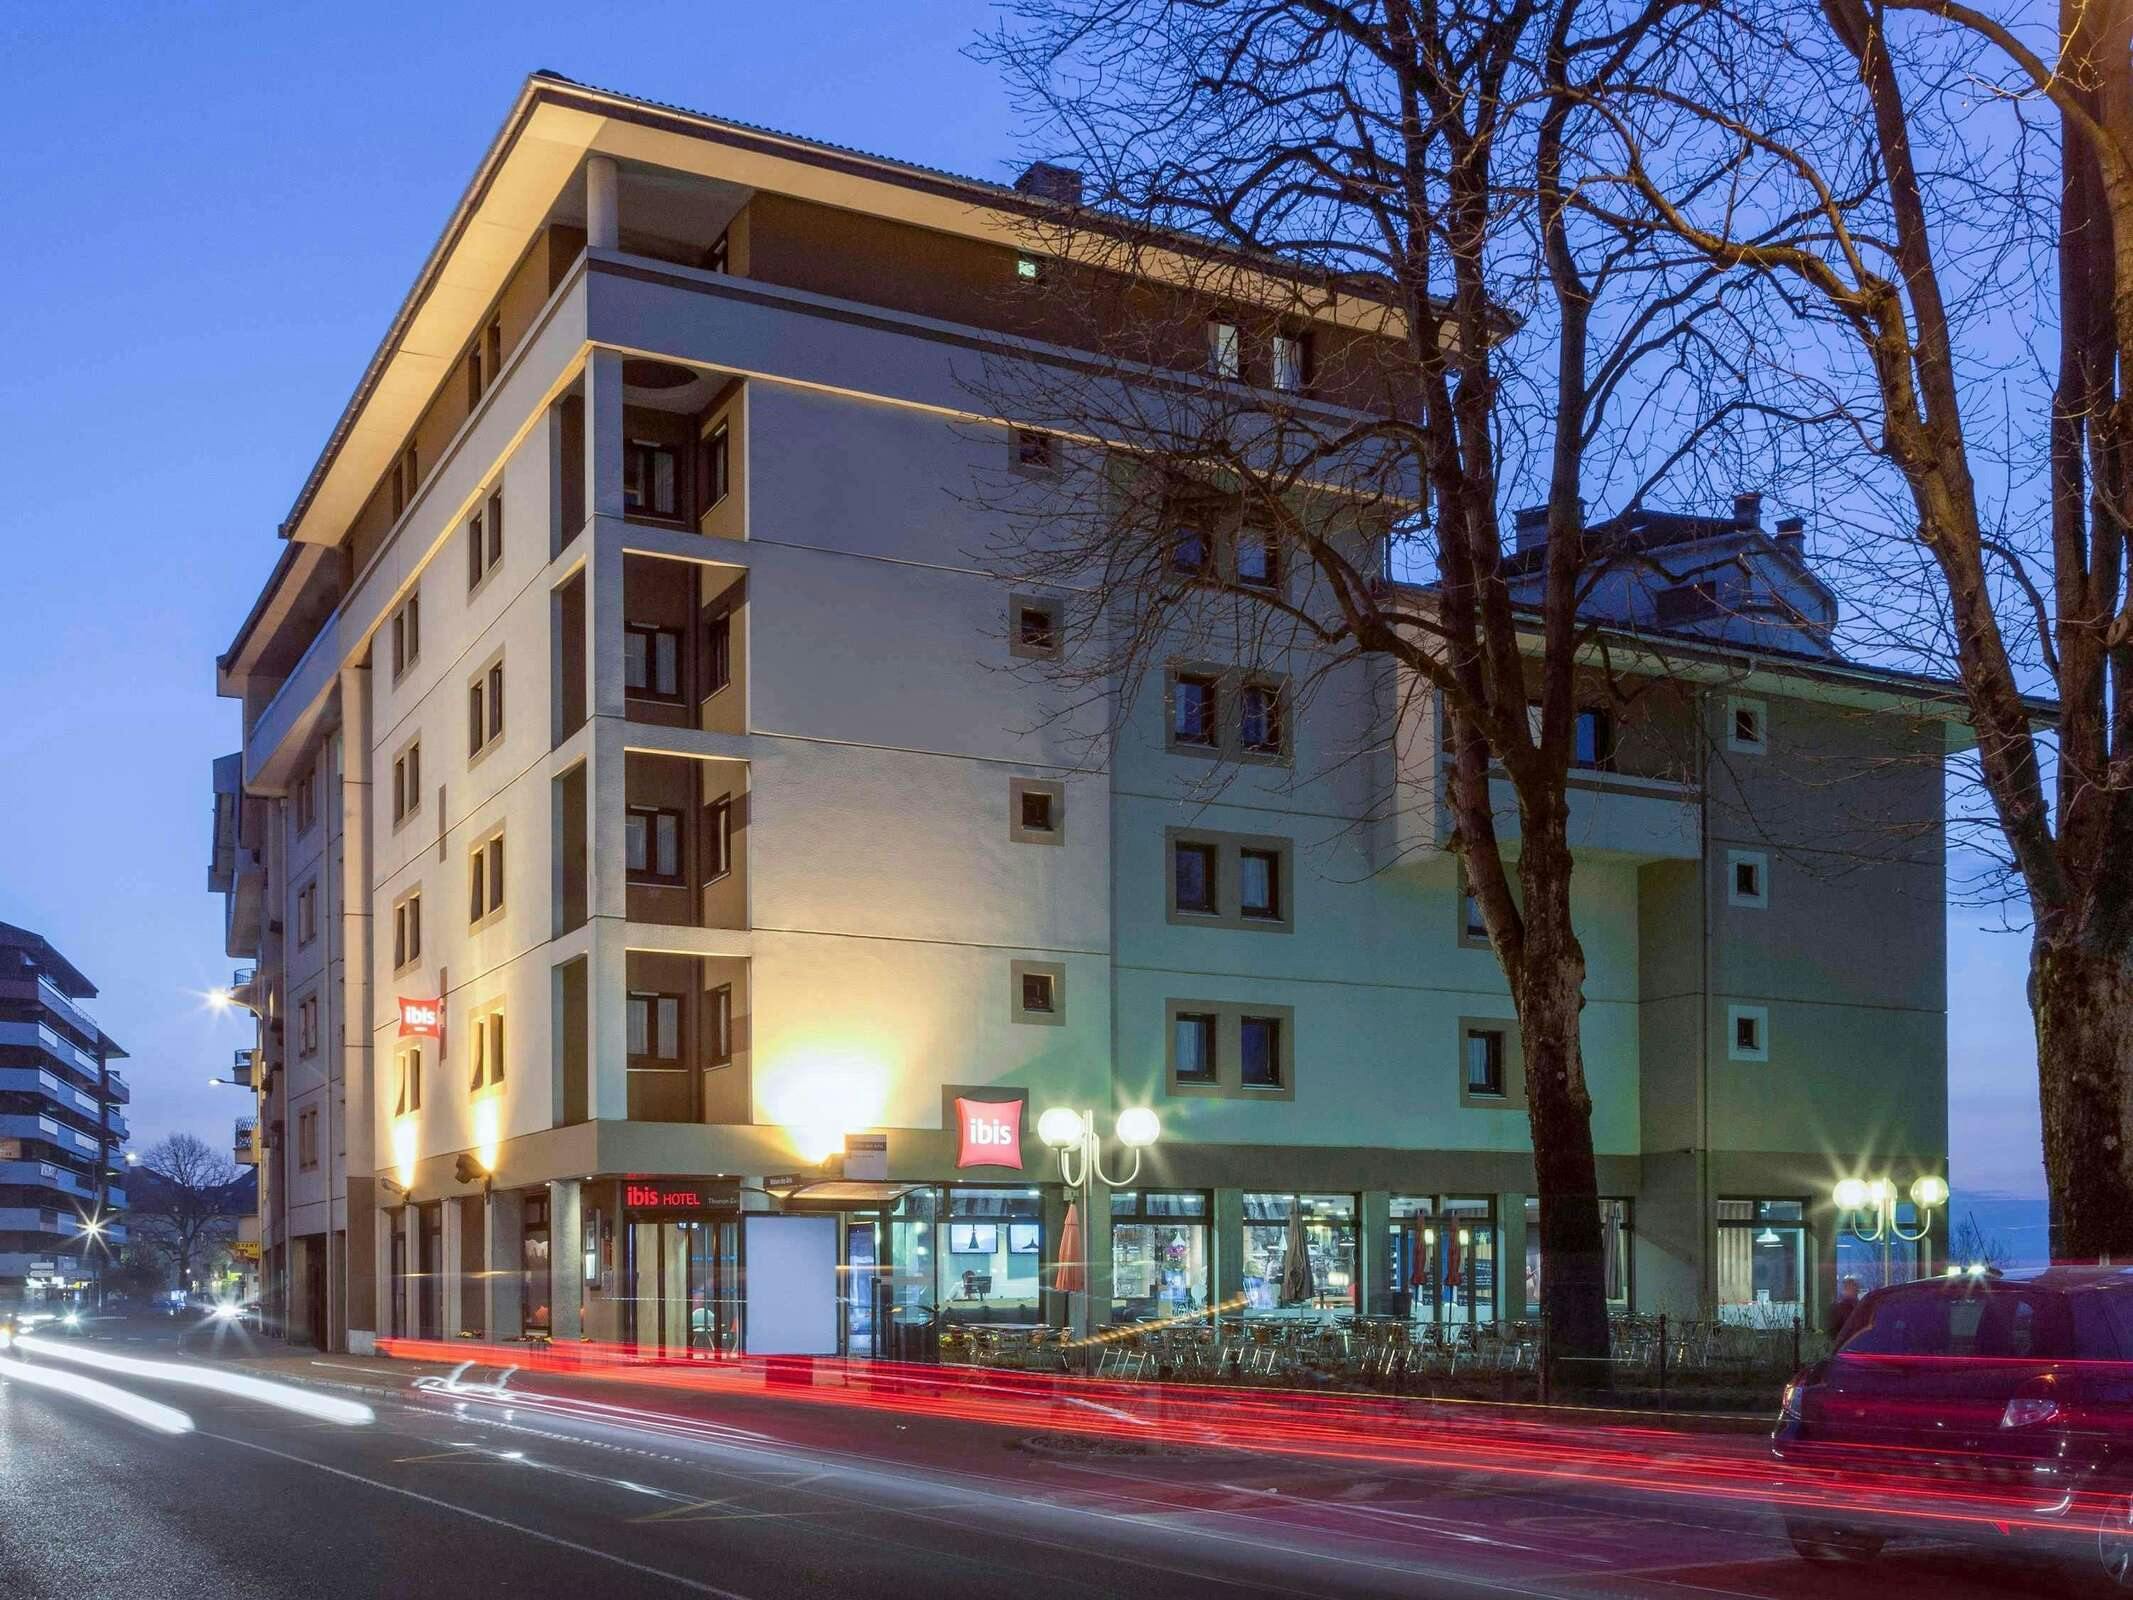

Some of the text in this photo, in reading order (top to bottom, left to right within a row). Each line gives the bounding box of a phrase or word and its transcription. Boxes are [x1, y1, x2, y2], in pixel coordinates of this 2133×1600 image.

[405, 1006, 436, 1024] ibis
[970, 1118, 1012, 1145] ibis
[627, 1186, 659, 1206] ibis
[663, 1193, 701, 1206] HOTEL
